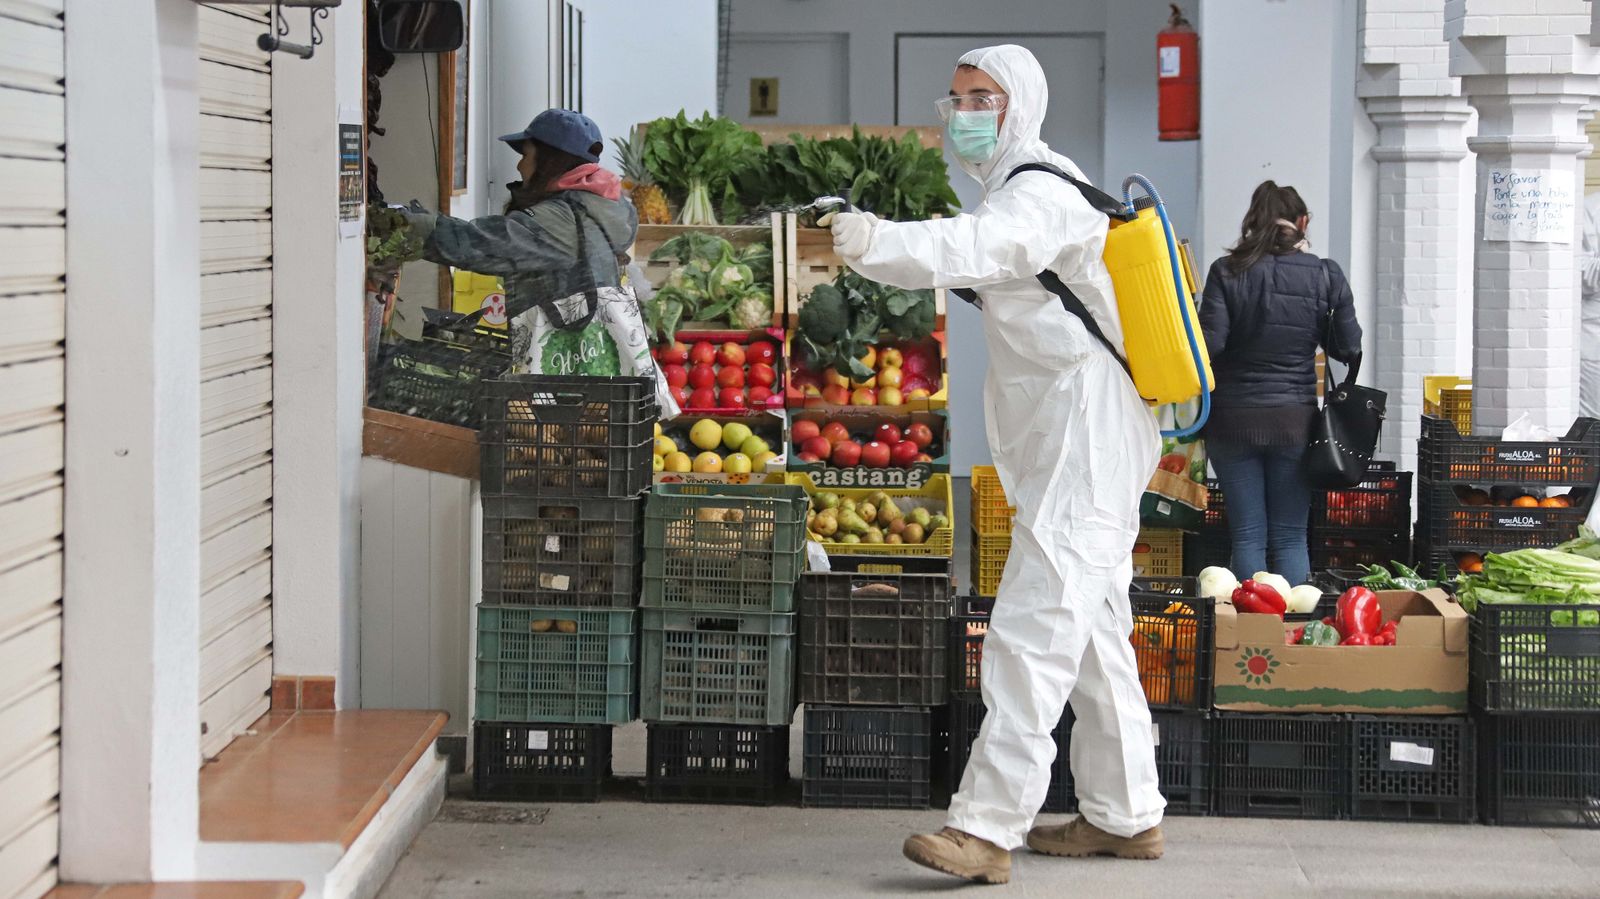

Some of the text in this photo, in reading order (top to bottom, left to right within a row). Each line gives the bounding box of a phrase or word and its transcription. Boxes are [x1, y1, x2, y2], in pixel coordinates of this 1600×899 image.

[1493, 172, 1542, 190] Por favor
[551, 331, 606, 376] Hola!
[808, 467, 922, 489] castang
[1513, 517, 1535, 525] ALOA
